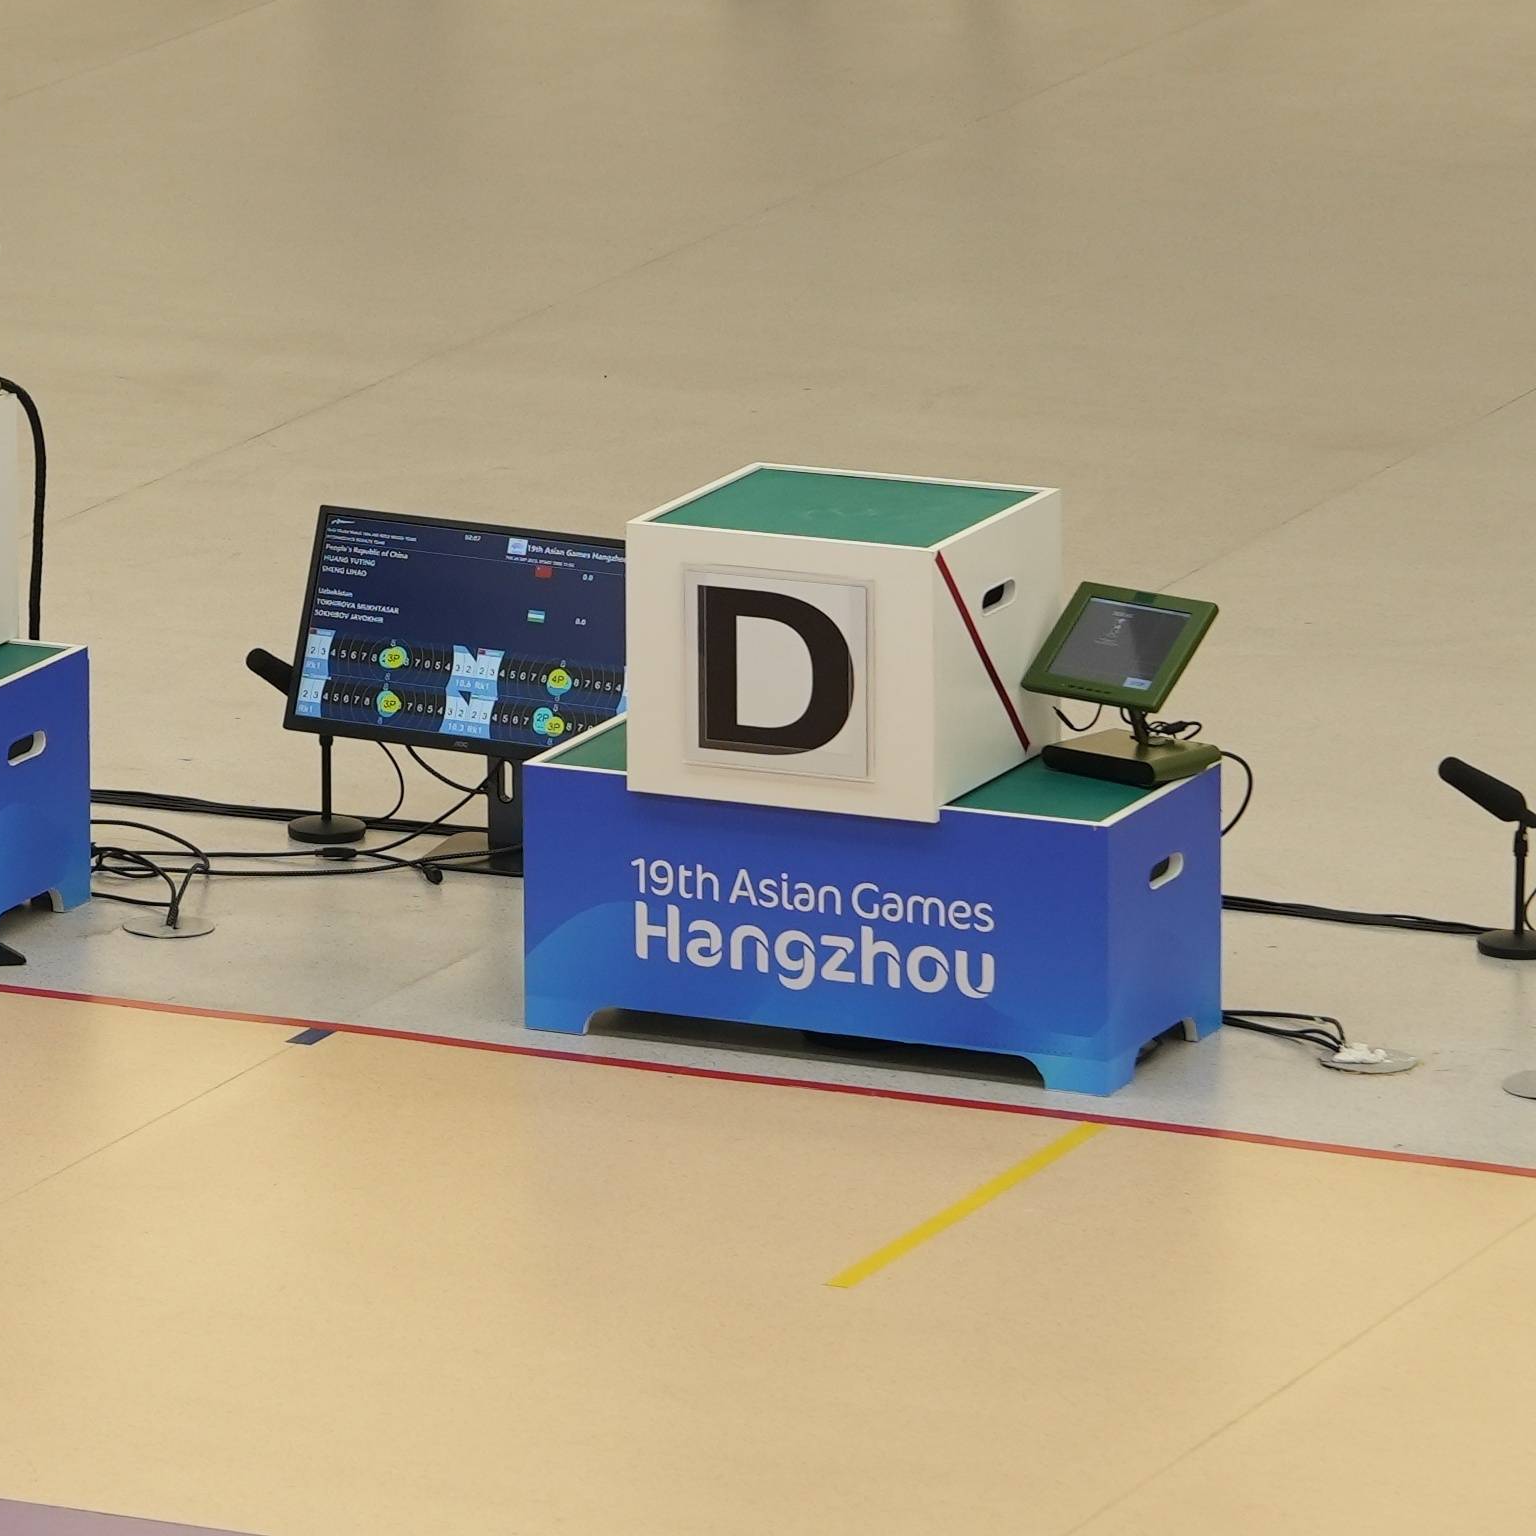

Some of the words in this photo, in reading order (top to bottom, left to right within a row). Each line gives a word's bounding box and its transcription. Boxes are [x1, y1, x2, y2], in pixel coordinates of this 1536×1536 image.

[698, 585, 854, 755] D
[630, 858, 720, 902] 19th
[729, 868, 842, 915] Asian
[851, 882, 995, 933] Games
[634, 900, 995, 999] Hangzhou
